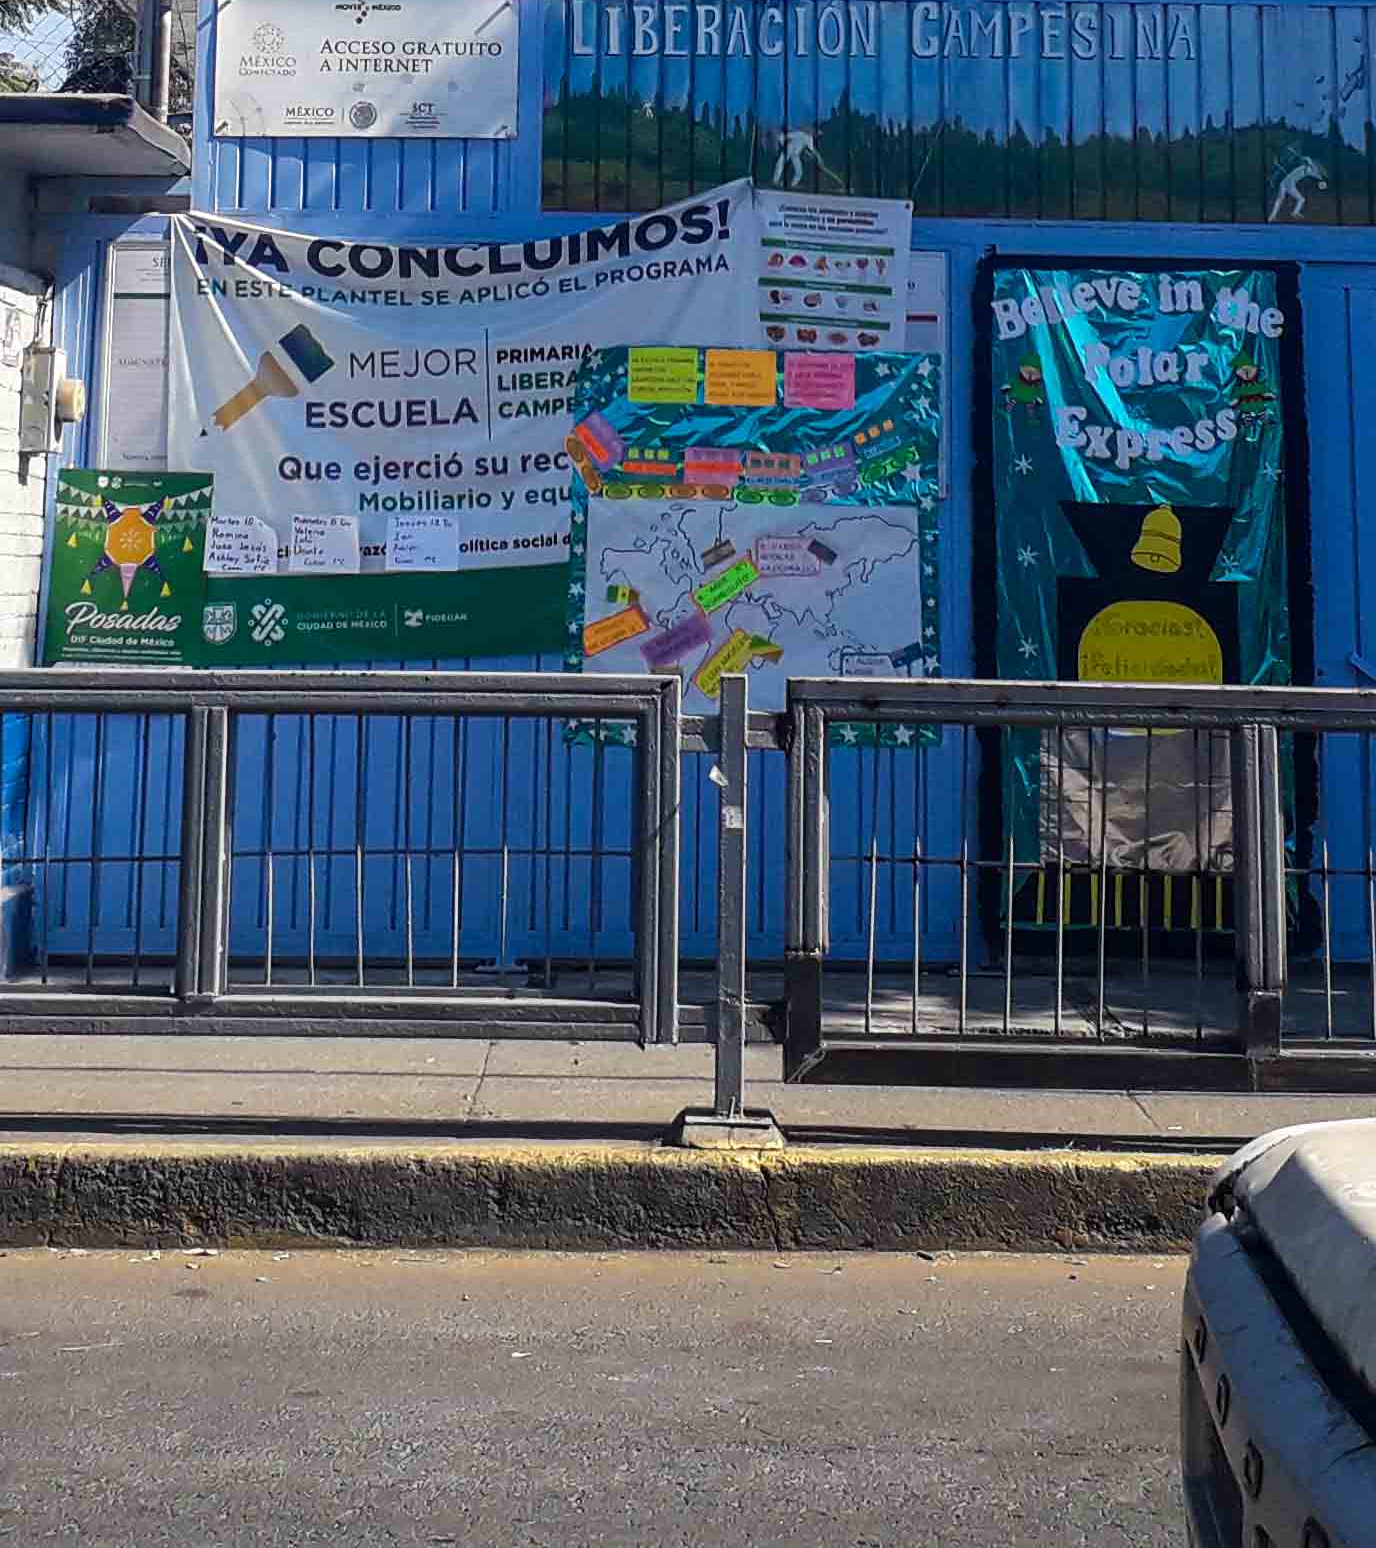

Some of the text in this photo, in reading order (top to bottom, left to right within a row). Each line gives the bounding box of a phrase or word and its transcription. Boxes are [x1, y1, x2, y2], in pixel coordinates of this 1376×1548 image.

[911, 1, 1197, 61] CAMPESINA
[239, 54, 297, 67] MÉXICO
[319, 38, 503, 57] ACCESO GRATUITO
[319, 59, 434, 74] A INTERNET
[284, 104, 335, 117] MÉXICO
[411, 103, 434, 114] SCT
[306, 199, 732, 279] CONCLUIMOS!
[197, 253, 730, 306] EN ESTE PLANTEL SE APLICÓ EL PROGRAMA
[990, 273, 1285, 341] Believe in the
[349, 348, 478, 379] MEJOR
[496, 343, 593, 365] PRIMARIA
[1083, 342, 1210, 388] Polar
[305, 399, 479, 429] ESCUELA
[1055, 405, 1238, 471] Express
[278, 451, 569, 485] Que ejerció su rec
[359, 490, 492, 512] Mobiliario
[500, 491, 515, 510] y
[513, 535, 558, 550] social
[64, 601, 183, 635] Posadas
[296, 618, 387, 631] CIUDAD DE MÉXICO
[89, 635, 124, 645] Ciudad
[125, 636, 139, 645] de
[140, 637, 176, 647] México
